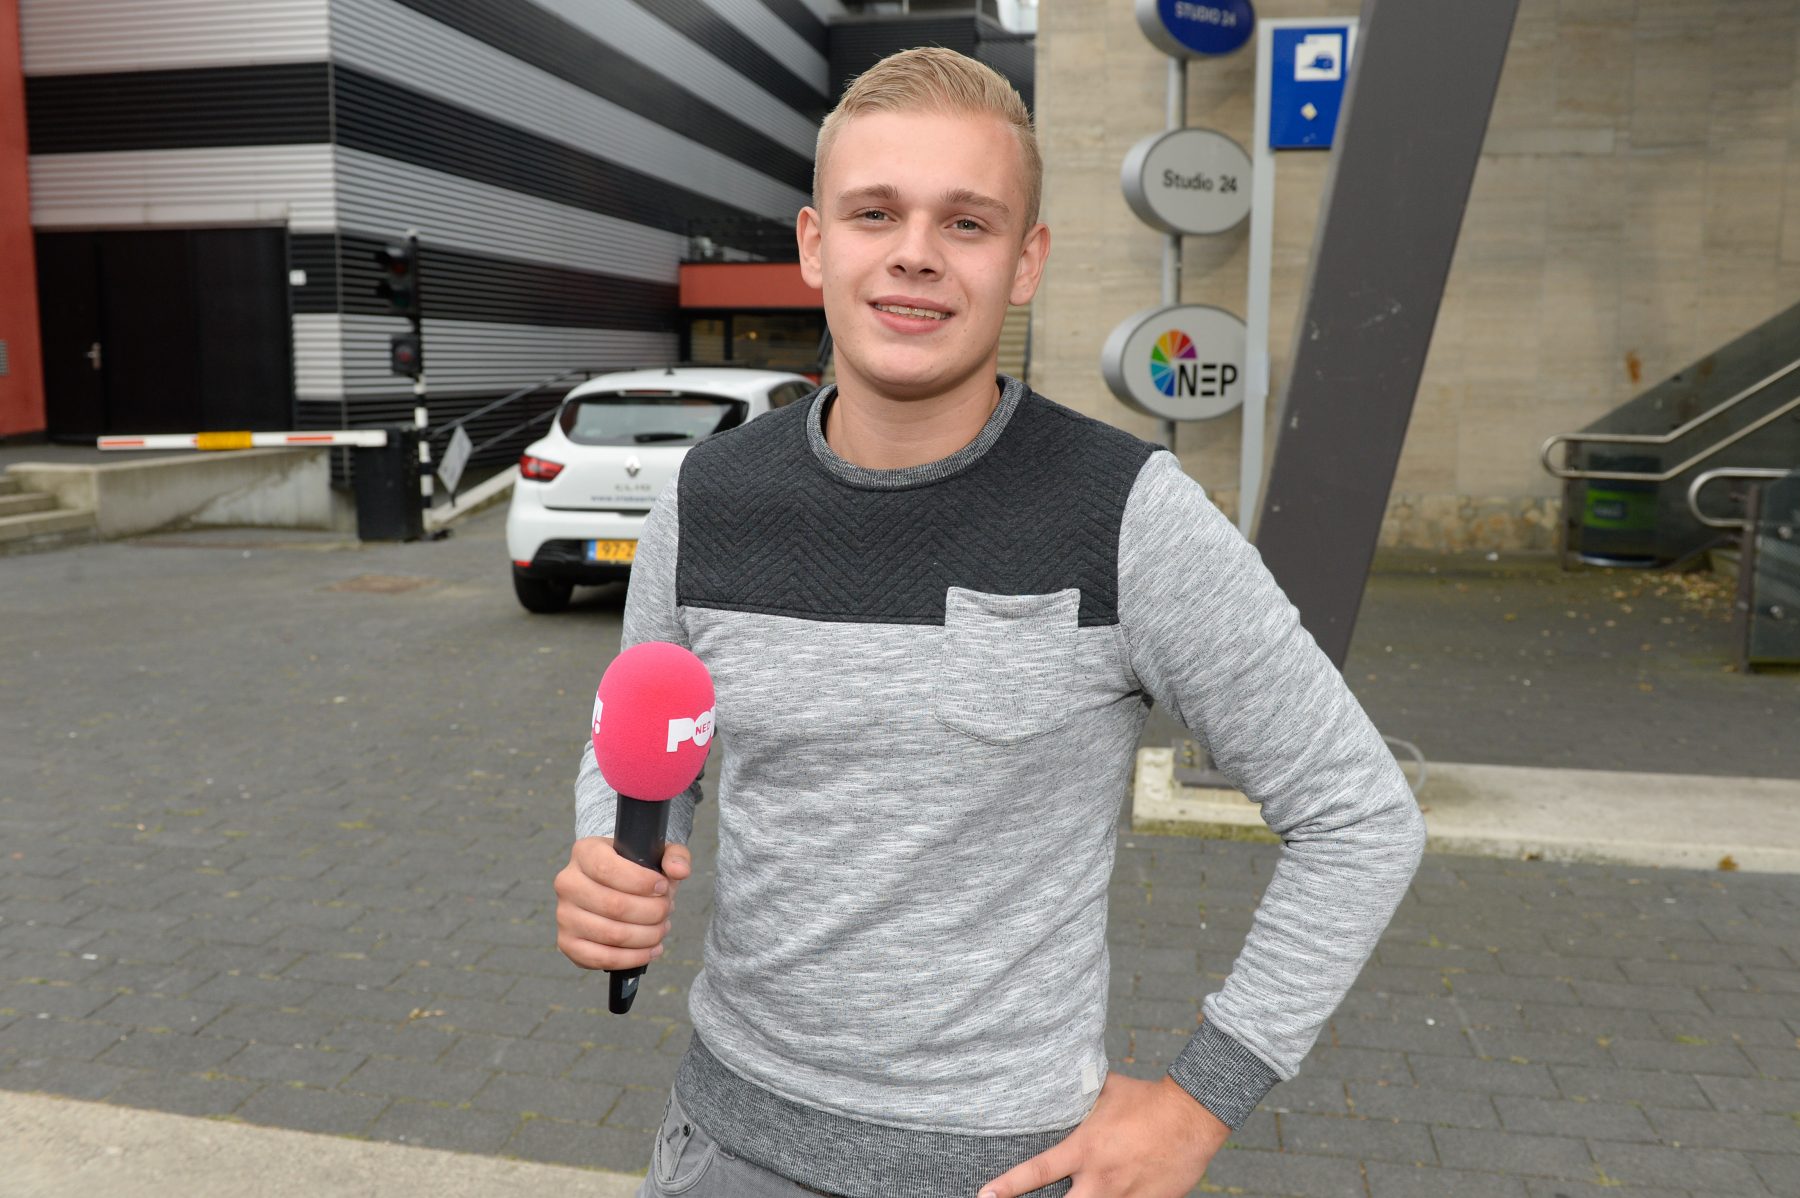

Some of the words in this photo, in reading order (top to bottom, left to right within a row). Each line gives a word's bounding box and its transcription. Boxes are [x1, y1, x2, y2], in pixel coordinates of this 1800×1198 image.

[1174, 1, 1220, 25] STUDIO
[1221, 9, 1237, 28] 24
[1163, 168, 1213, 192] Studio
[1219, 173, 1237, 194] 24
[1178, 363, 1238, 398] NEP
[666, 706, 716, 752] PO
